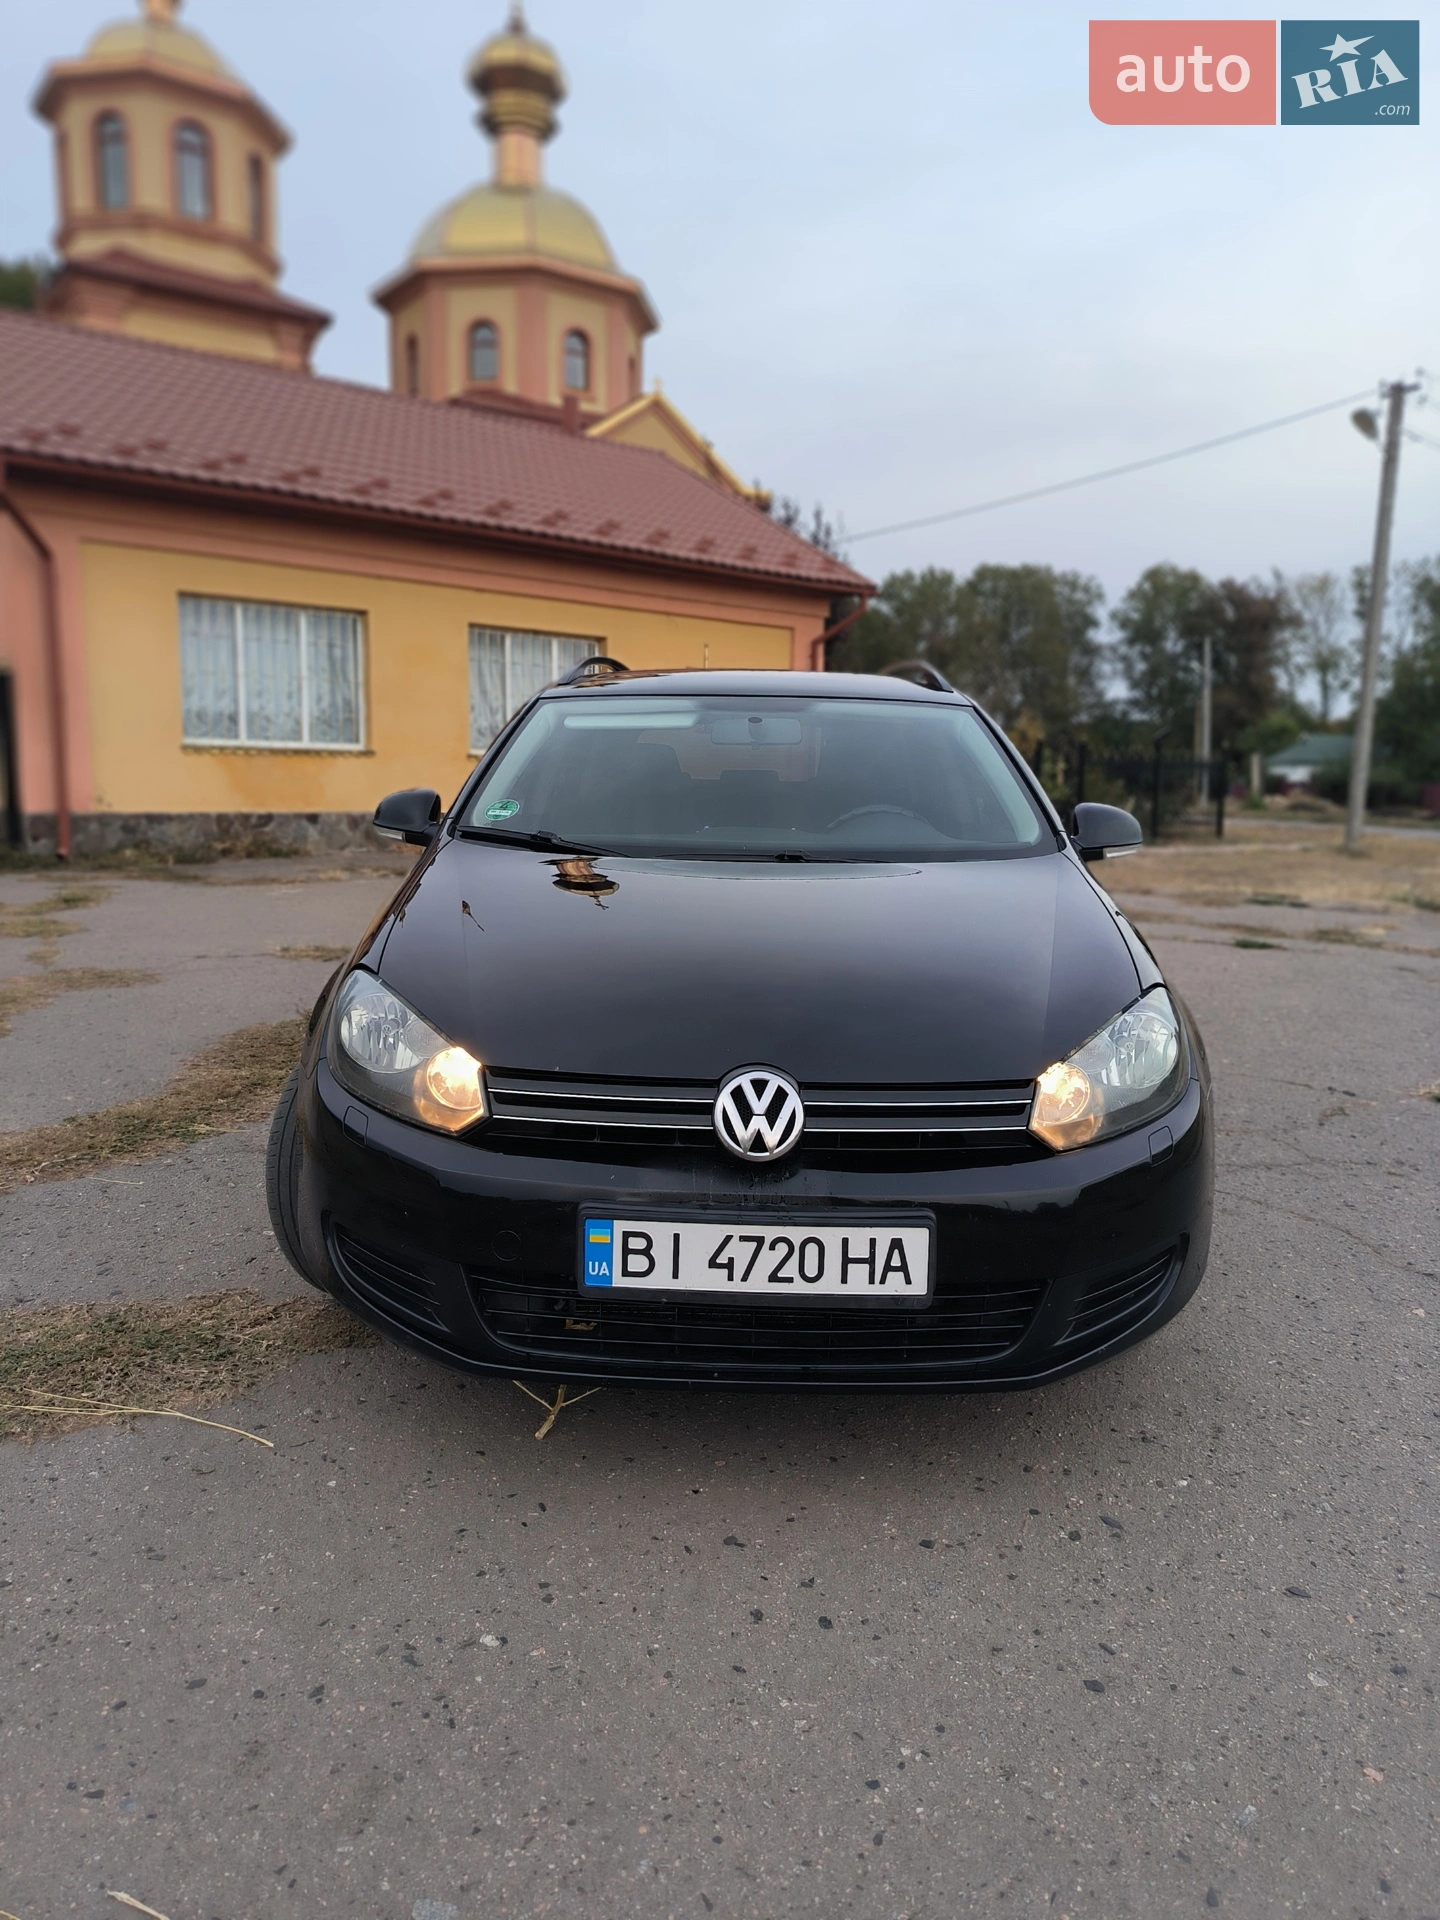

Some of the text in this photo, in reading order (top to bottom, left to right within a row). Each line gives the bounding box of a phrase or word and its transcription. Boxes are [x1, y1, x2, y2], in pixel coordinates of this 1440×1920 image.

[715, 1071, 804, 1157] VW
[588, 1261, 610, 1276] UA
[708, 1234, 825, 1284] 4720
[840, 1237, 912, 1285] HA
